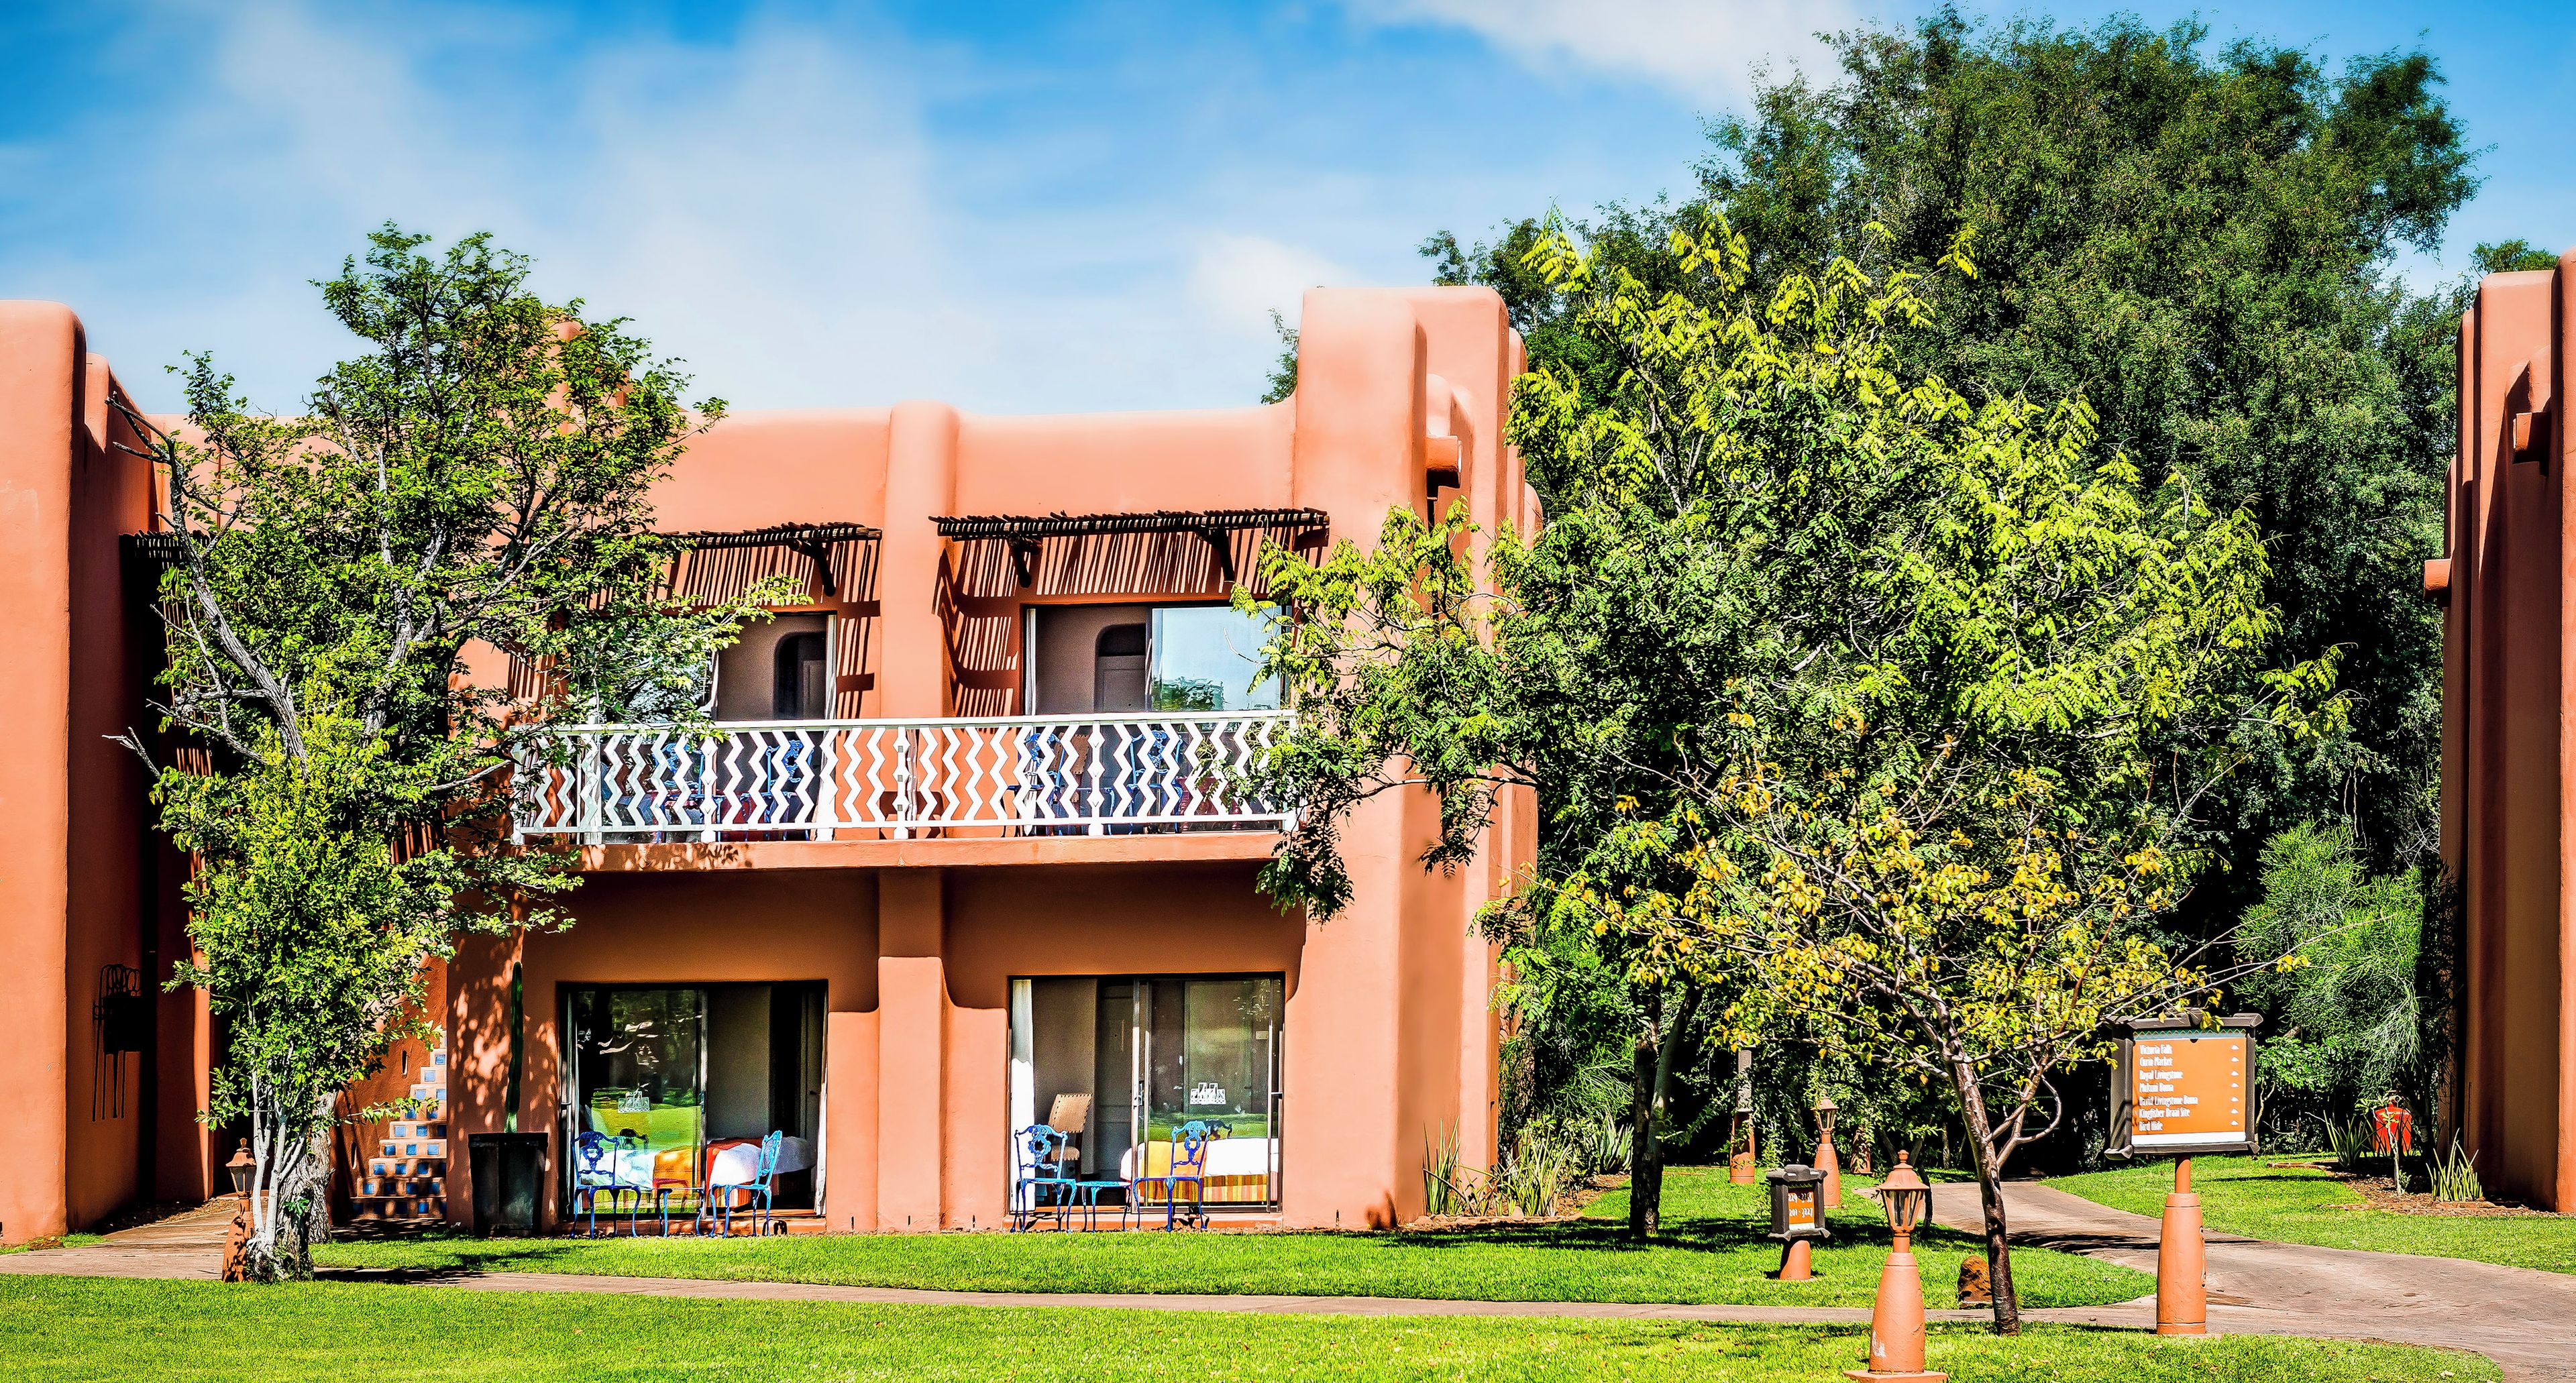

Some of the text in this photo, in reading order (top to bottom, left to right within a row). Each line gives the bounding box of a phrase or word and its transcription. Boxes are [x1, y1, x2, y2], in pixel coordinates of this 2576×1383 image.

[2139, 1044, 2173, 1054] Victoria Falls
[2139, 1056, 2173, 1066] Curio Market
[2139, 1070, 2183, 1081] Royal Livingstone
[2139, 1083, 2159, 1093] Mukuni
[2139, 1096, 2153, 1105] David
[2154, 1096, 2183, 1107] Livingstone
[2139, 1107, 2190, 1119] Kingfisher Braai Site
[2139, 1120, 2163, 1131] Bird Hide
